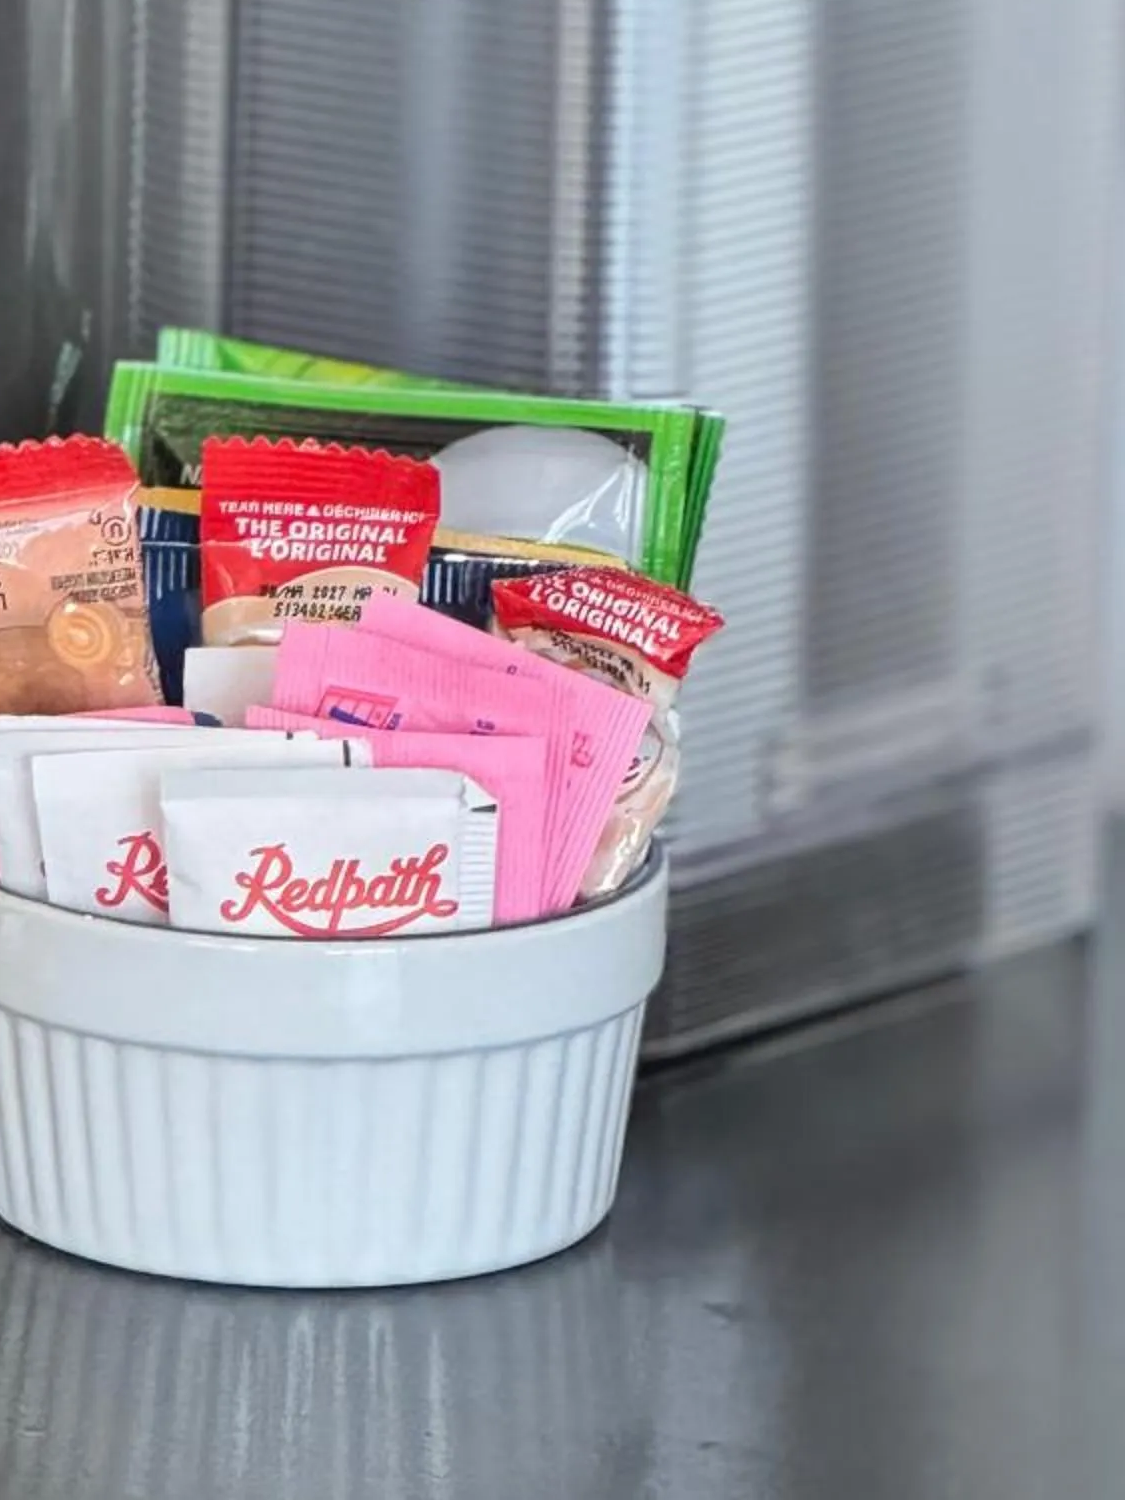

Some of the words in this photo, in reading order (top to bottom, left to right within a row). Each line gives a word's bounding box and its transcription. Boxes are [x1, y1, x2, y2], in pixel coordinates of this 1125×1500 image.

[263, 502, 304, 517] HERE
[235, 517, 283, 538] THE
[288, 520, 408, 545] ORIGINAL
[249, 537, 387, 563] L'ORIGINAL
[529, 582, 659, 658] L'ORIGINAL
[220, 842, 460, 937] Redpath
